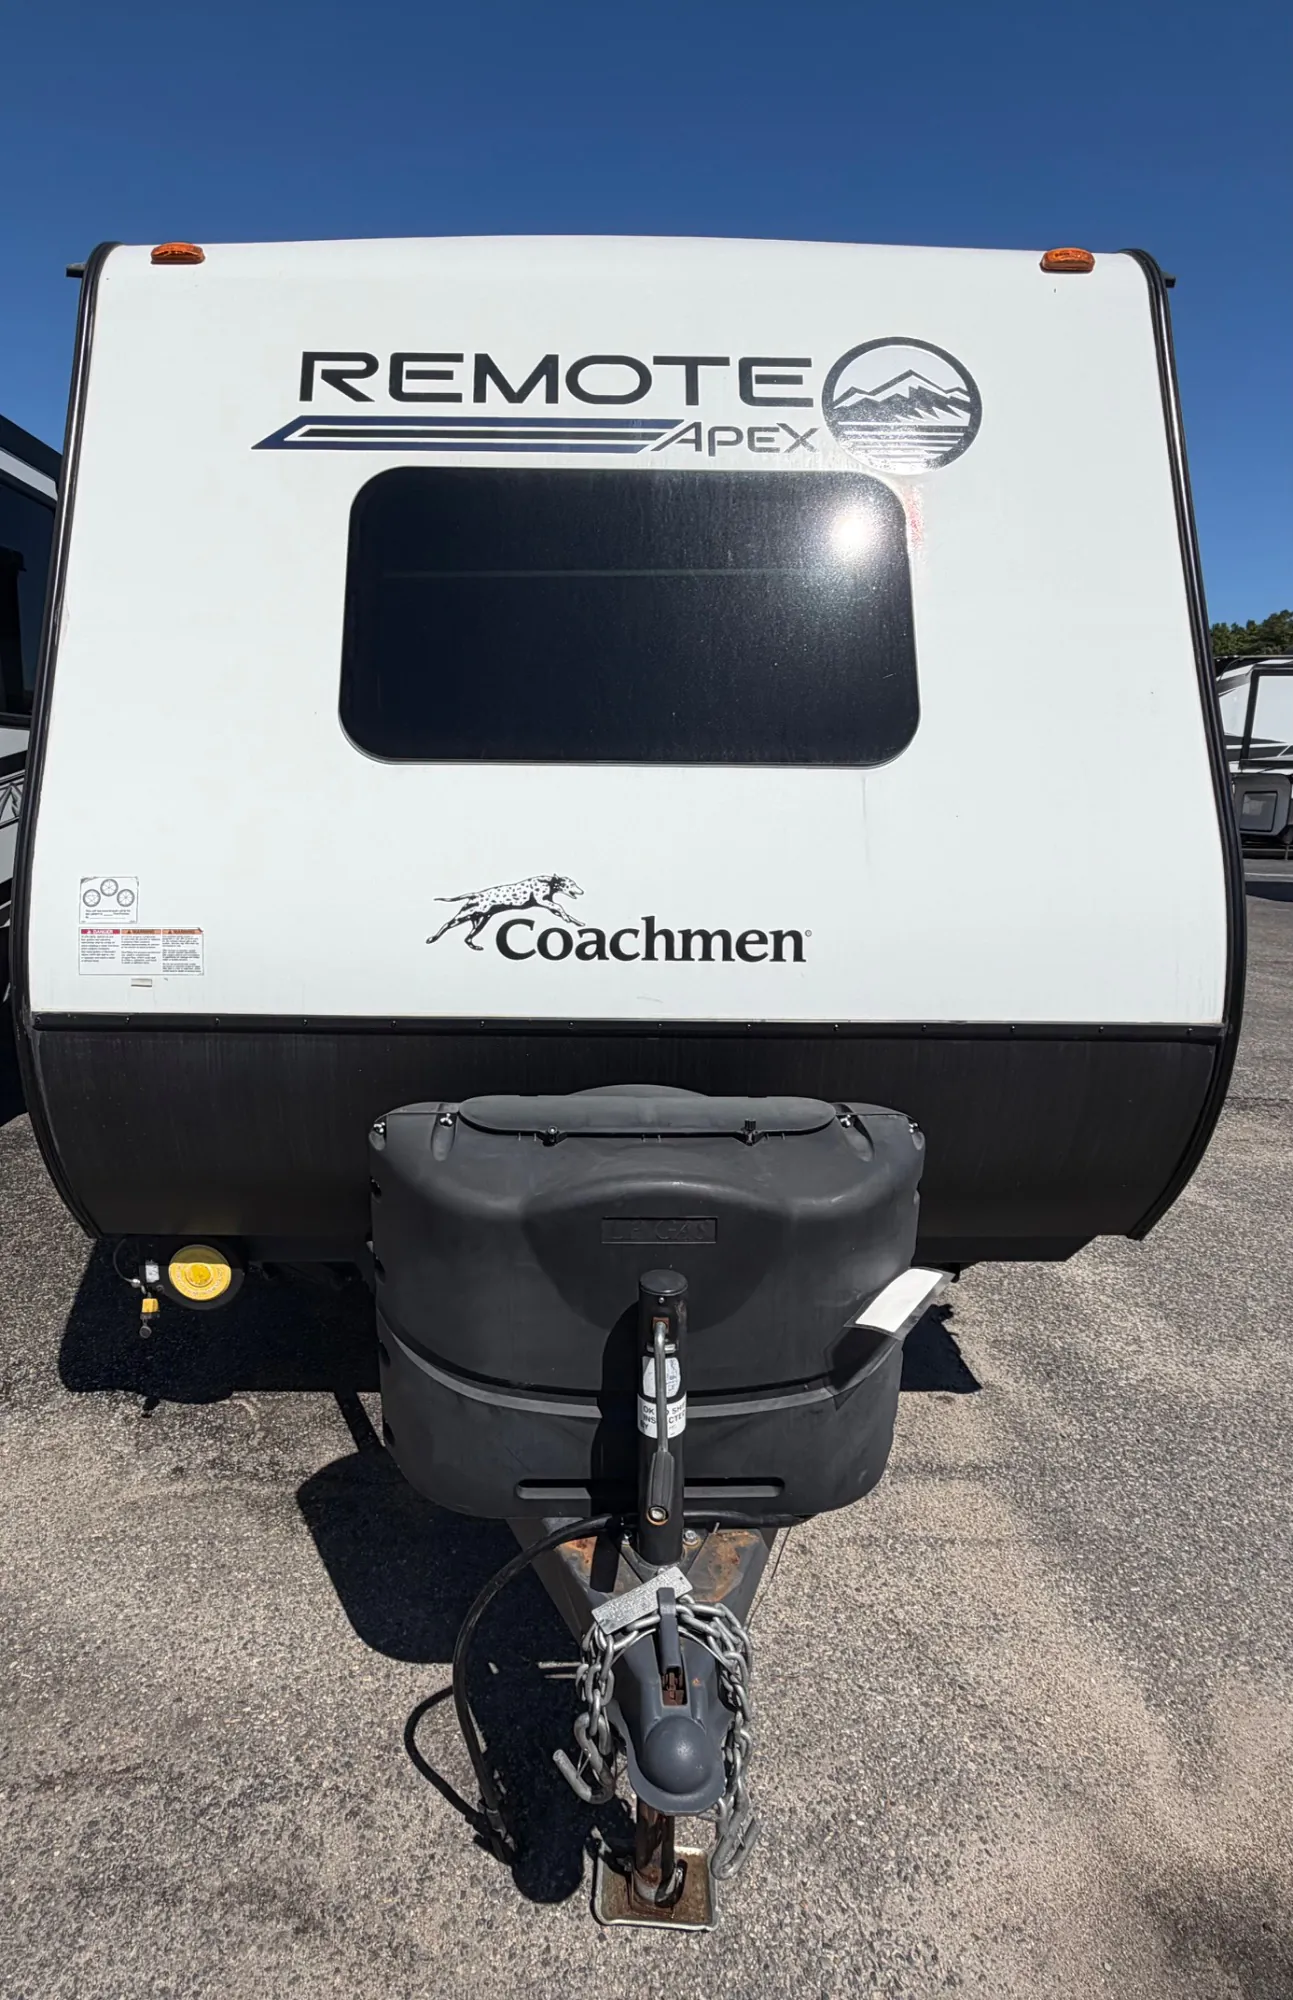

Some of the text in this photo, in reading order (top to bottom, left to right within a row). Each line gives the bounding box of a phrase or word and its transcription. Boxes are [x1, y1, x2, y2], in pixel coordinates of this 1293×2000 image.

[299, 351, 813, 407] REMOTE
[650, 421, 820, 457] APEX
[655, 1219, 707, 1241] GAS
[643, 1405, 655, 1415] OK
